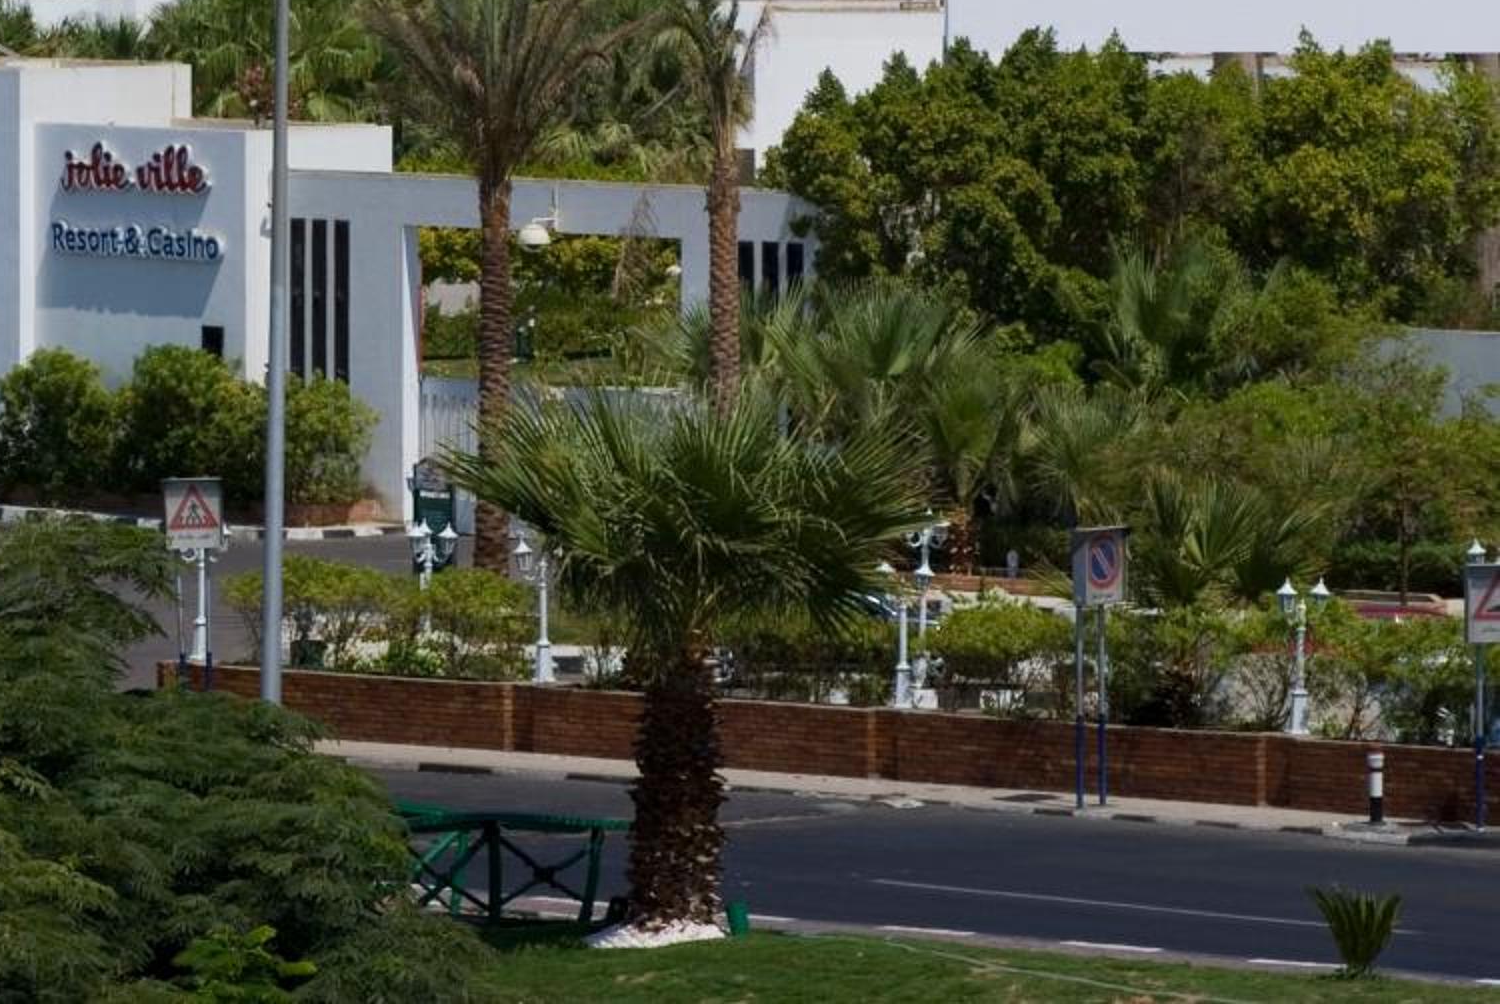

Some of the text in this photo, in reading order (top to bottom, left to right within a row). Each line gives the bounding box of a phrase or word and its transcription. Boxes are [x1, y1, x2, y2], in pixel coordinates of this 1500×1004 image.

[61, 141, 212, 193] jolie ville
[52, 222, 222, 260] Resort & Casino
